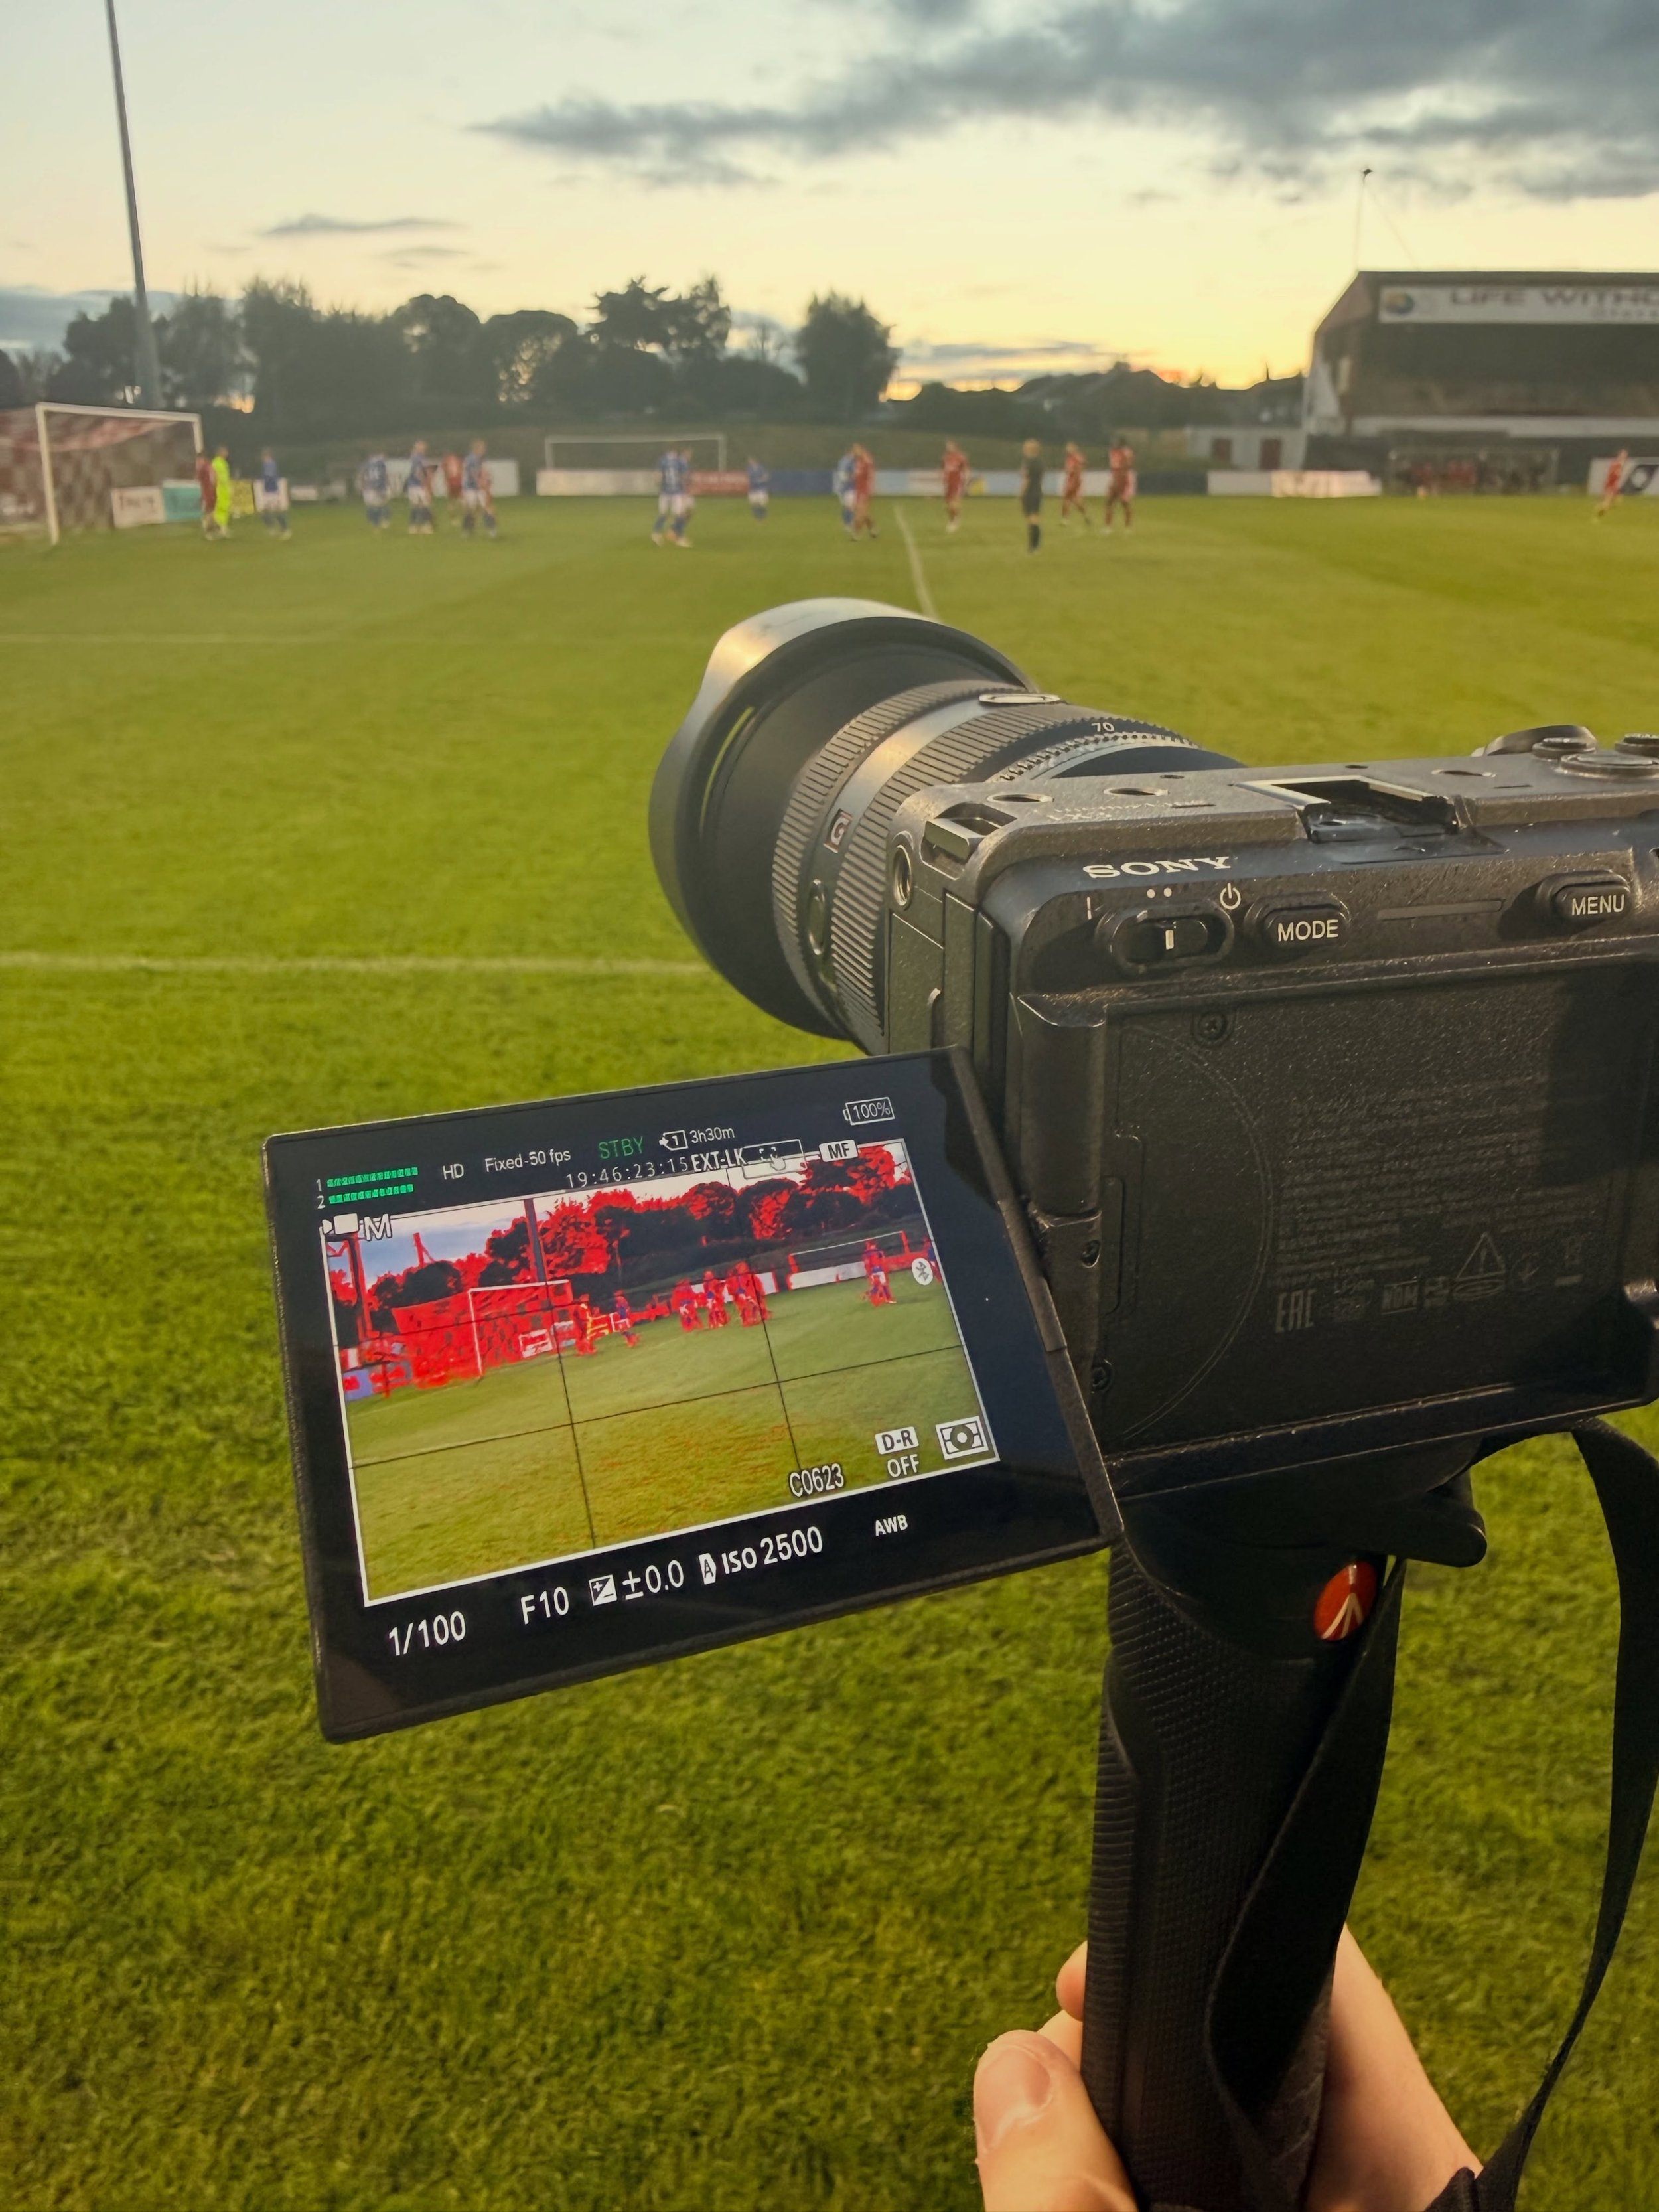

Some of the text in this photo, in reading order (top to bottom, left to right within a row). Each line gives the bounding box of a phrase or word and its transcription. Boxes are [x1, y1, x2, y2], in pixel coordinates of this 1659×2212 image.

[1450, 287, 1525, 305] LIFE
[1092, 722, 1115, 733] 70
[1082, 856, 1231, 879] SONY
[1571, 894, 1625, 916] MENU
[1277, 919, 1339, 942] MODE
[853, 1102, 892, 1120] 100%
[690, 1126, 735, 1143] 3h30m
[549, 1148, 571, 1166] fps
[599, 1137, 643, 1159] STBY
[828, 1143, 851, 1159] MF
[443, 1163, 464, 1180] HD
[363, 1213, 392, 1242] M
[883, 1430, 914, 1451] D-R
[887, 1454, 920, 1478] OFF
[789, 1463, 844, 1497] C0623
[875, 1514, 908, 1537] AWB
[721, 1546, 757, 1575] ISO
[760, 1526, 823, 1566] 2500
[622, 1559, 684, 1601] ±0.0
[520, 1586, 569, 1624] F10
[388, 1611, 466, 1656] 1/100
